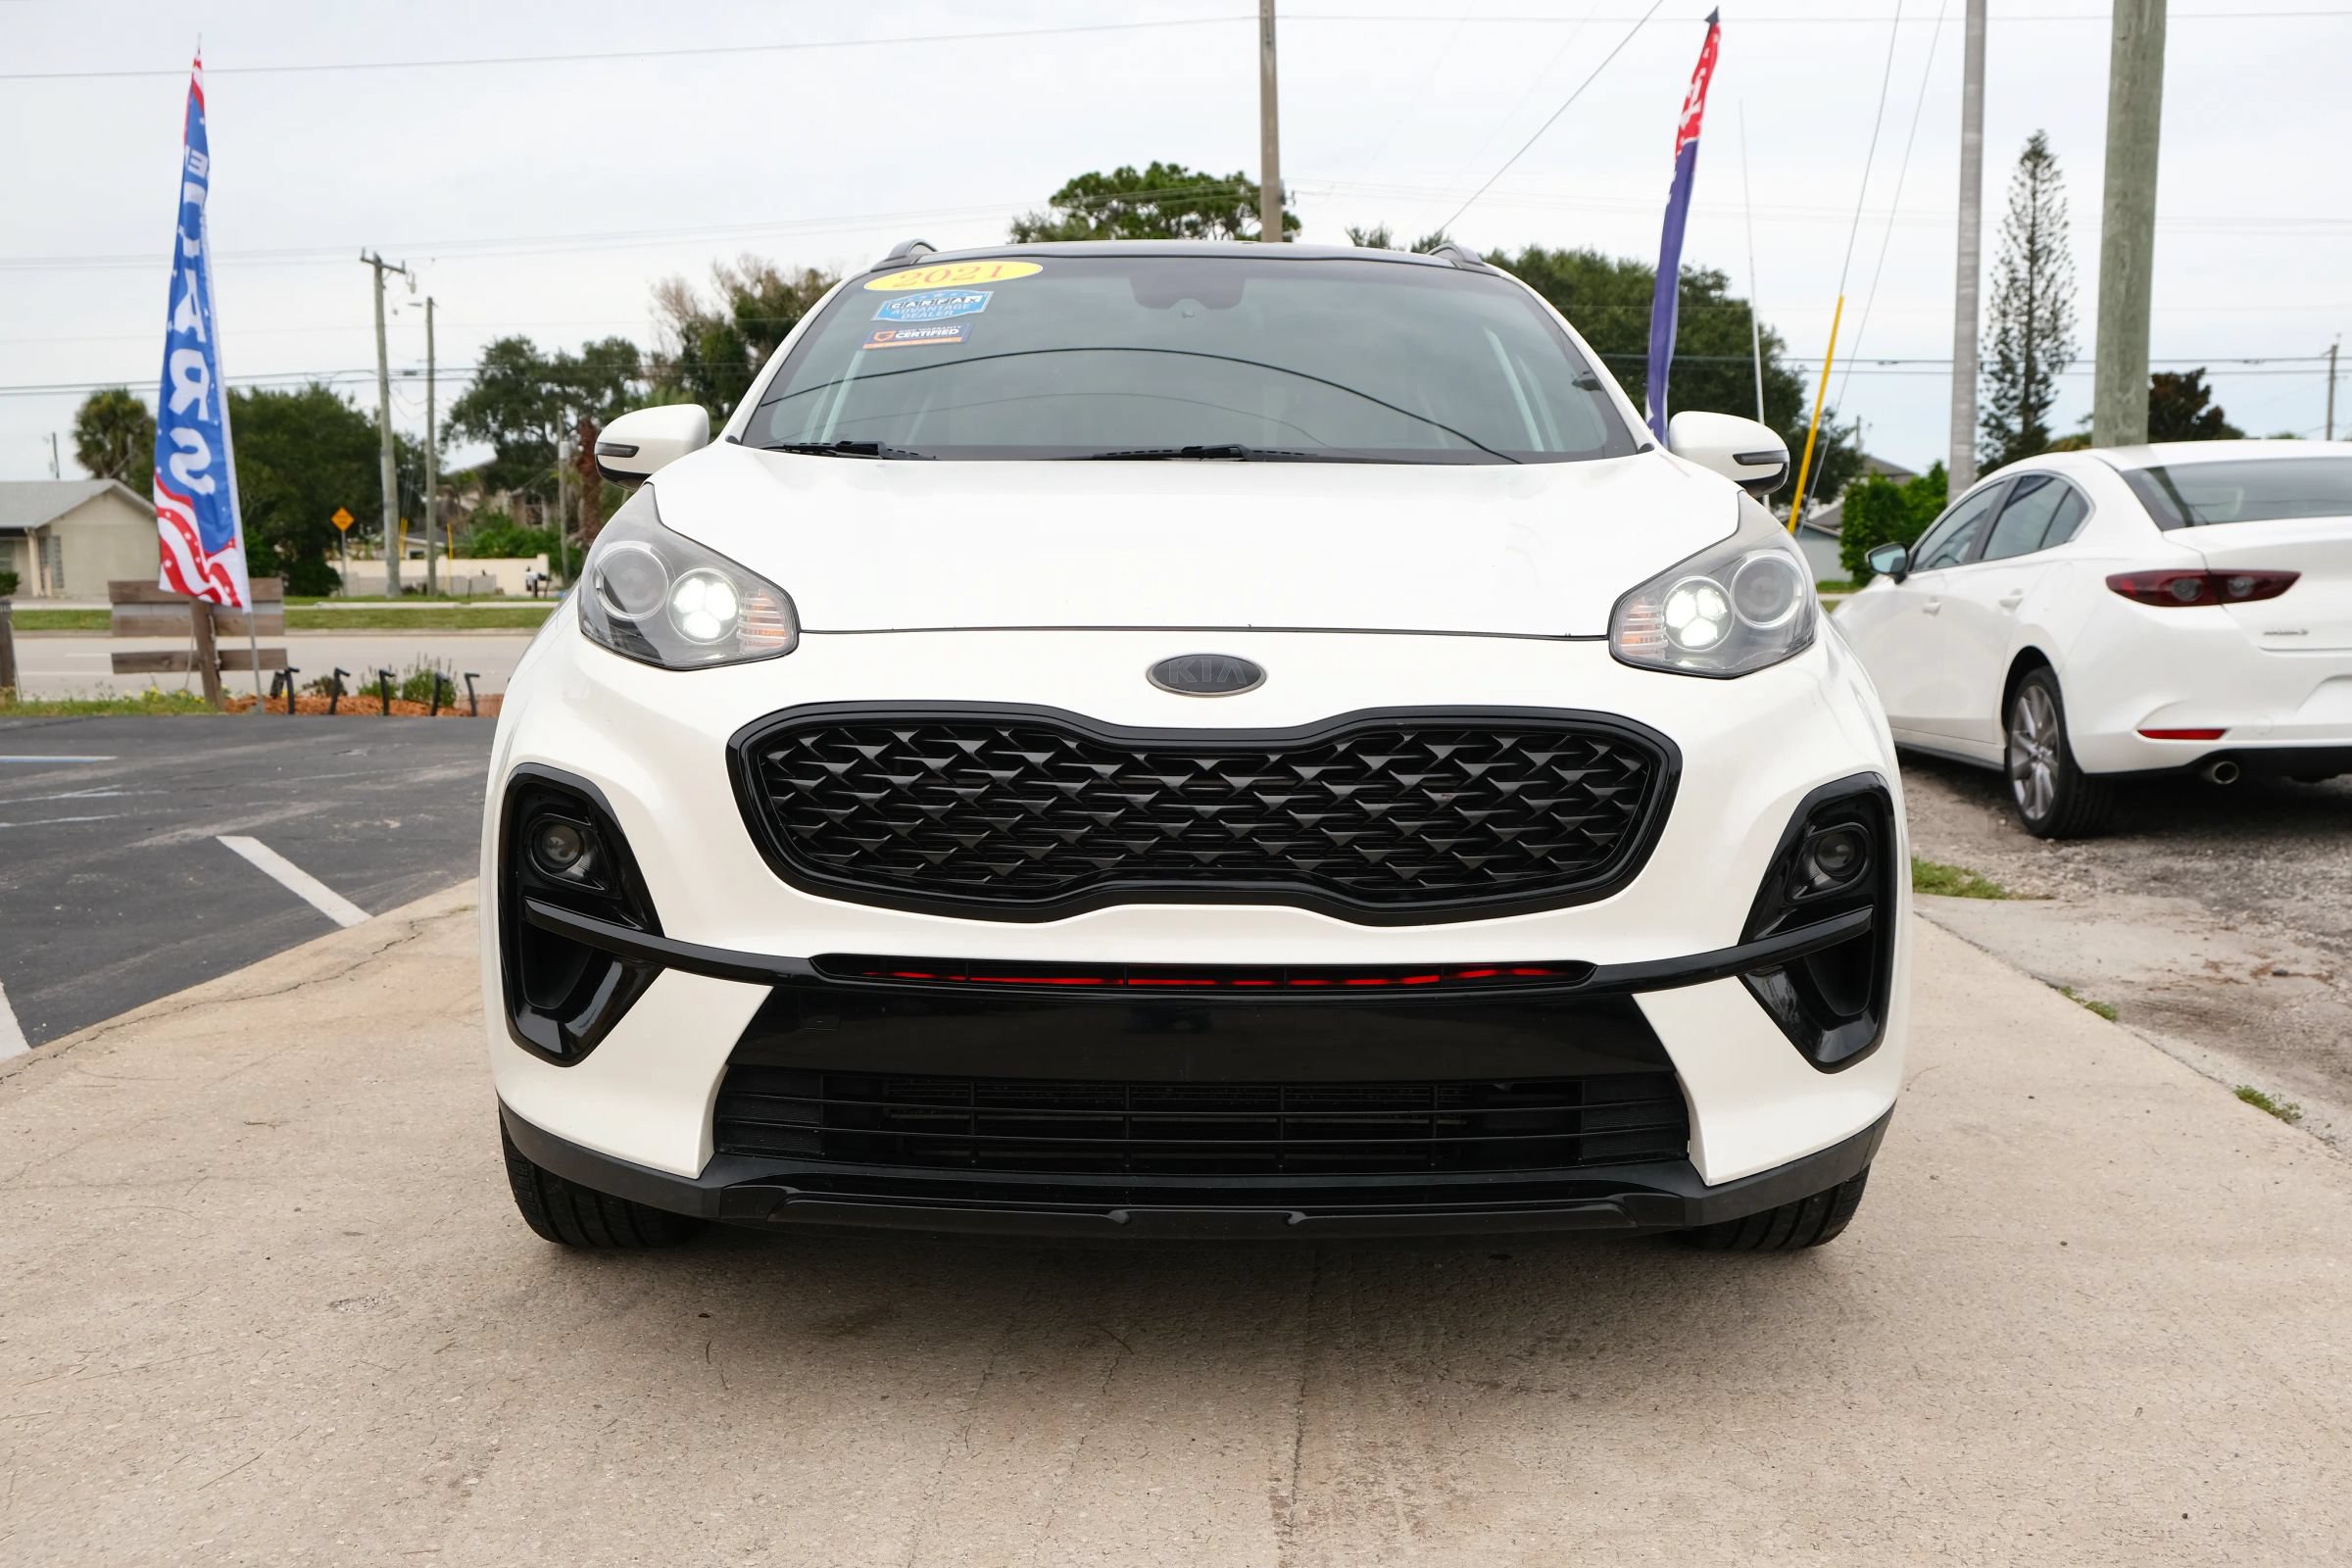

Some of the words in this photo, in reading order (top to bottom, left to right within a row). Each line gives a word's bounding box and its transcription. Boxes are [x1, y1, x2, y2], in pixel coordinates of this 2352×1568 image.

[893, 265, 1004, 287] 2021
[891, 303, 971, 315] ADVANTAGE
[901, 309, 955, 319] DEALER
[895, 328, 960, 339] CERTIFIED
[1168, 659, 1248, 684] KIA
